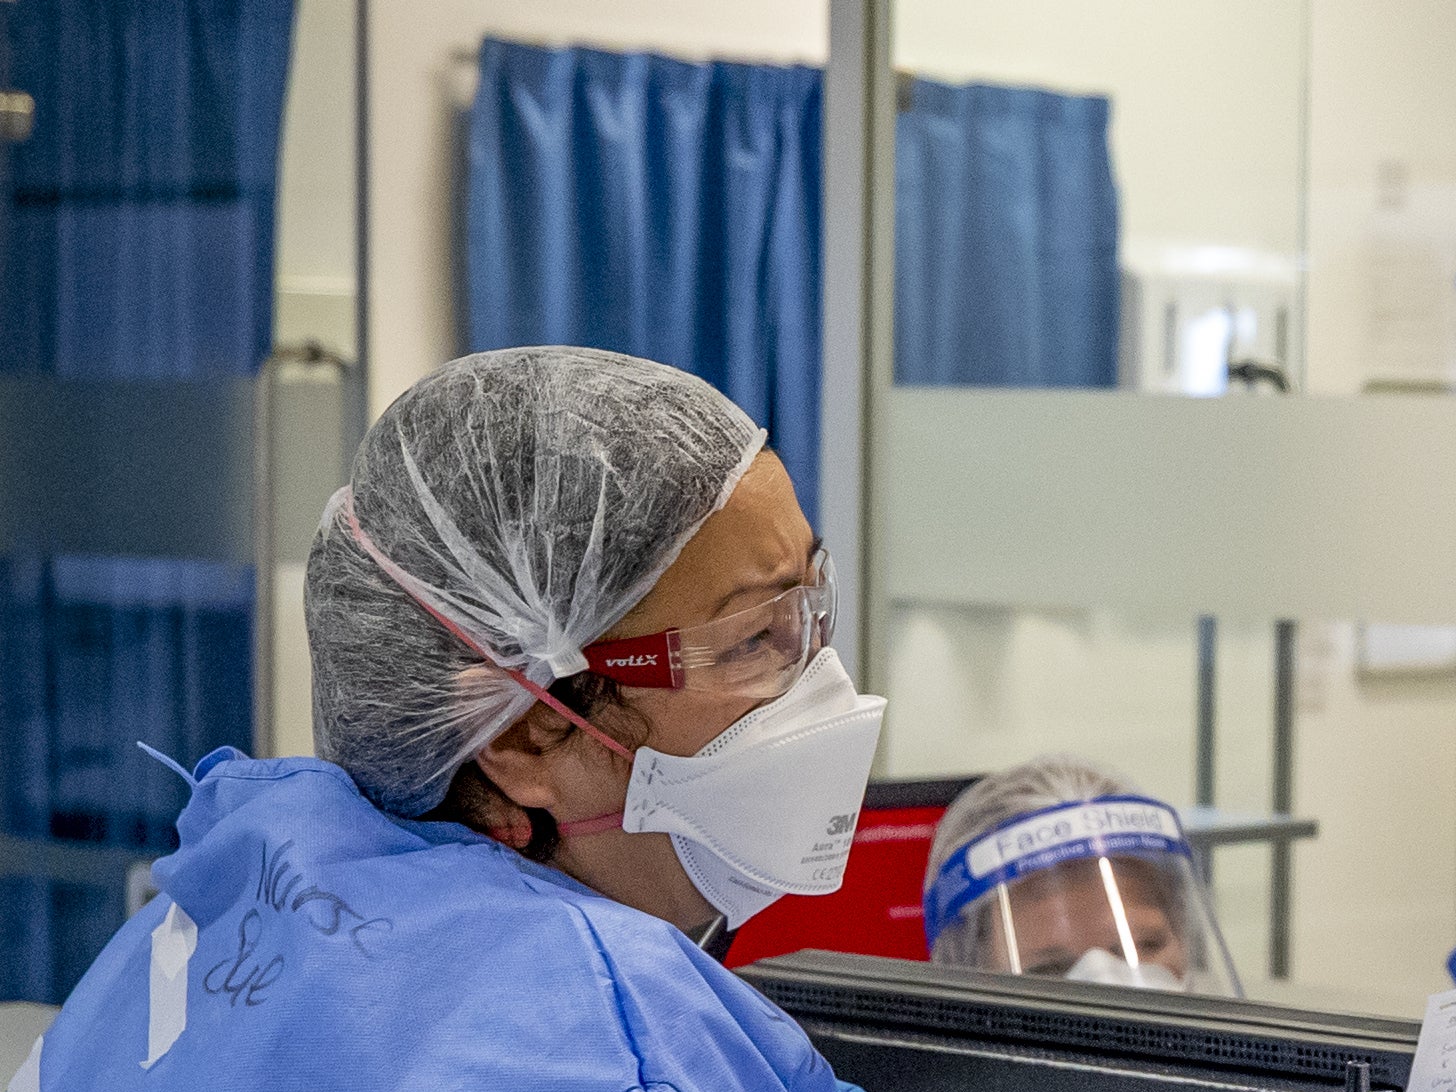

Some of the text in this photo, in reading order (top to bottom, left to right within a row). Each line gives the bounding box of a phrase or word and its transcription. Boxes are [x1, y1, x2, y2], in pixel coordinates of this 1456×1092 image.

[826, 812, 857, 836] 3M
[996, 807, 1164, 860] Face Shield
